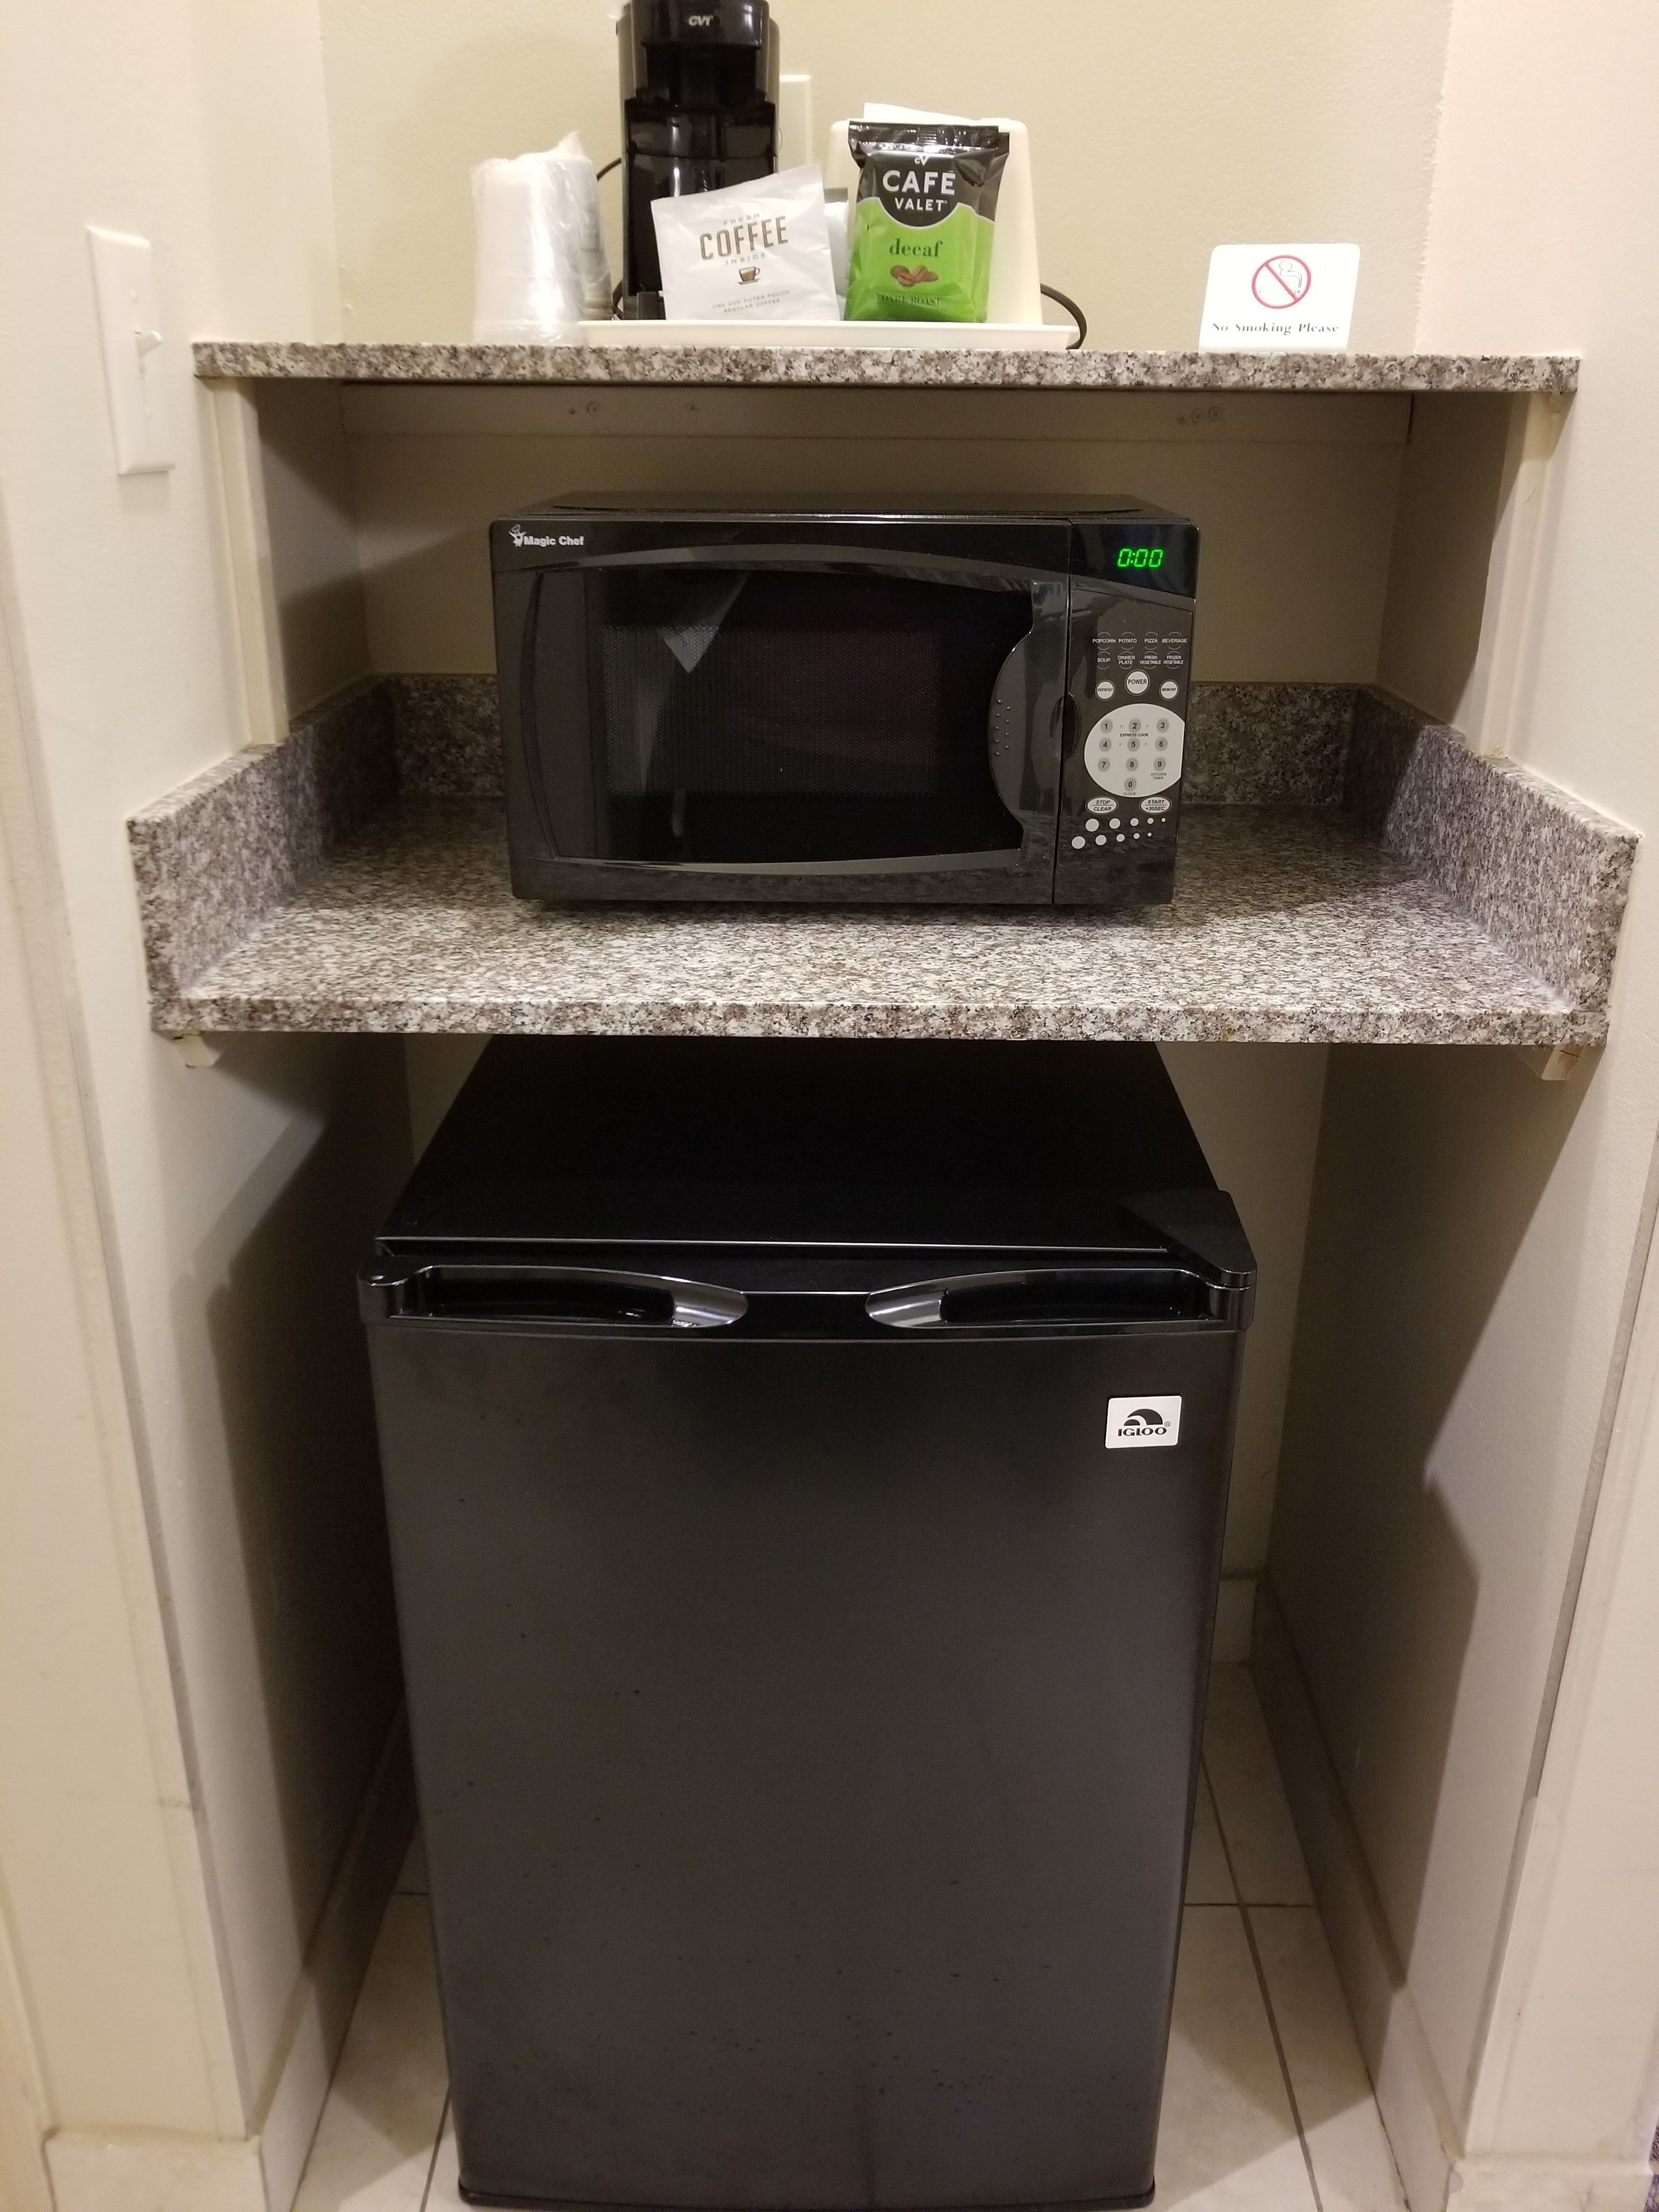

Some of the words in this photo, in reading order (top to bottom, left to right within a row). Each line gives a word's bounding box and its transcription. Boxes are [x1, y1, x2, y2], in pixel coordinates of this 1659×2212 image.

[895, 198, 944, 211] VALET
[724, 213, 760, 226] FRESH
[700, 216, 788, 260] COFFEE
[889, 238, 943, 257] decaf
[726, 252, 766, 265] INSIDE
[724, 304, 753, 313] REGULAR
[756, 298, 780, 306] COFFEE
[911, 296, 941, 306] ROAST
[1212, 323, 1229, 332] No
[1235, 323, 1291, 335] Smoking
[1298, 323, 1339, 332] Please
[524, 536, 556, 547] Magic
[558, 536, 584, 546] Chef
[1118, 549, 1163, 567] 0:00
[1118, 1427, 1167, 1437] IGLOO
